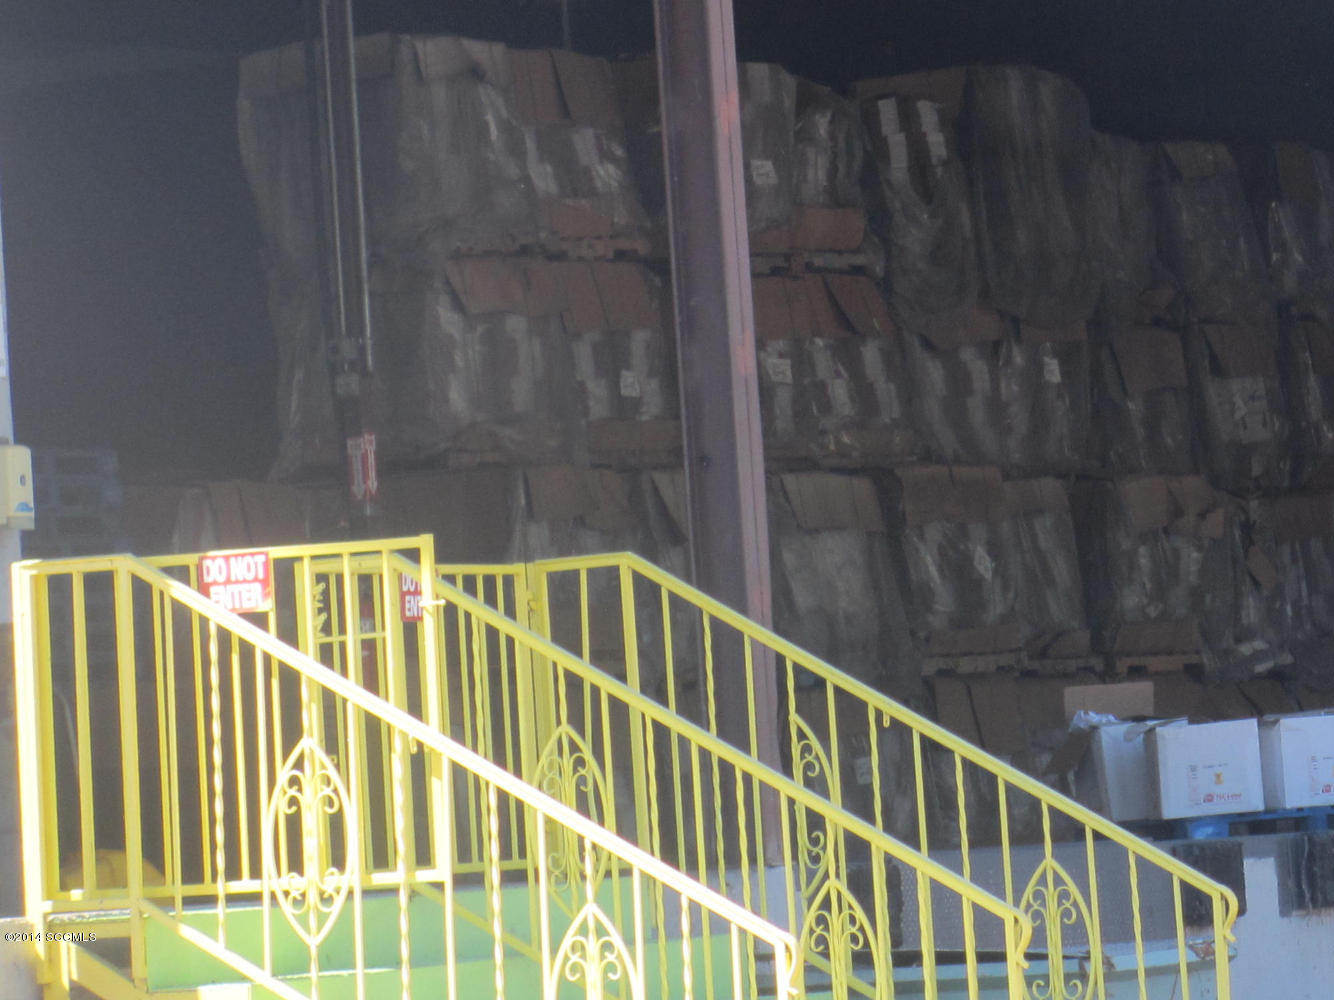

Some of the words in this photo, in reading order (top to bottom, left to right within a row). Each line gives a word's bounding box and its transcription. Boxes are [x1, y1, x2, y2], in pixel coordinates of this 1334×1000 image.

[202, 559, 228, 583] DO
[229, 554, 266, 582] NOT
[209, 582, 264, 611] ENTER
